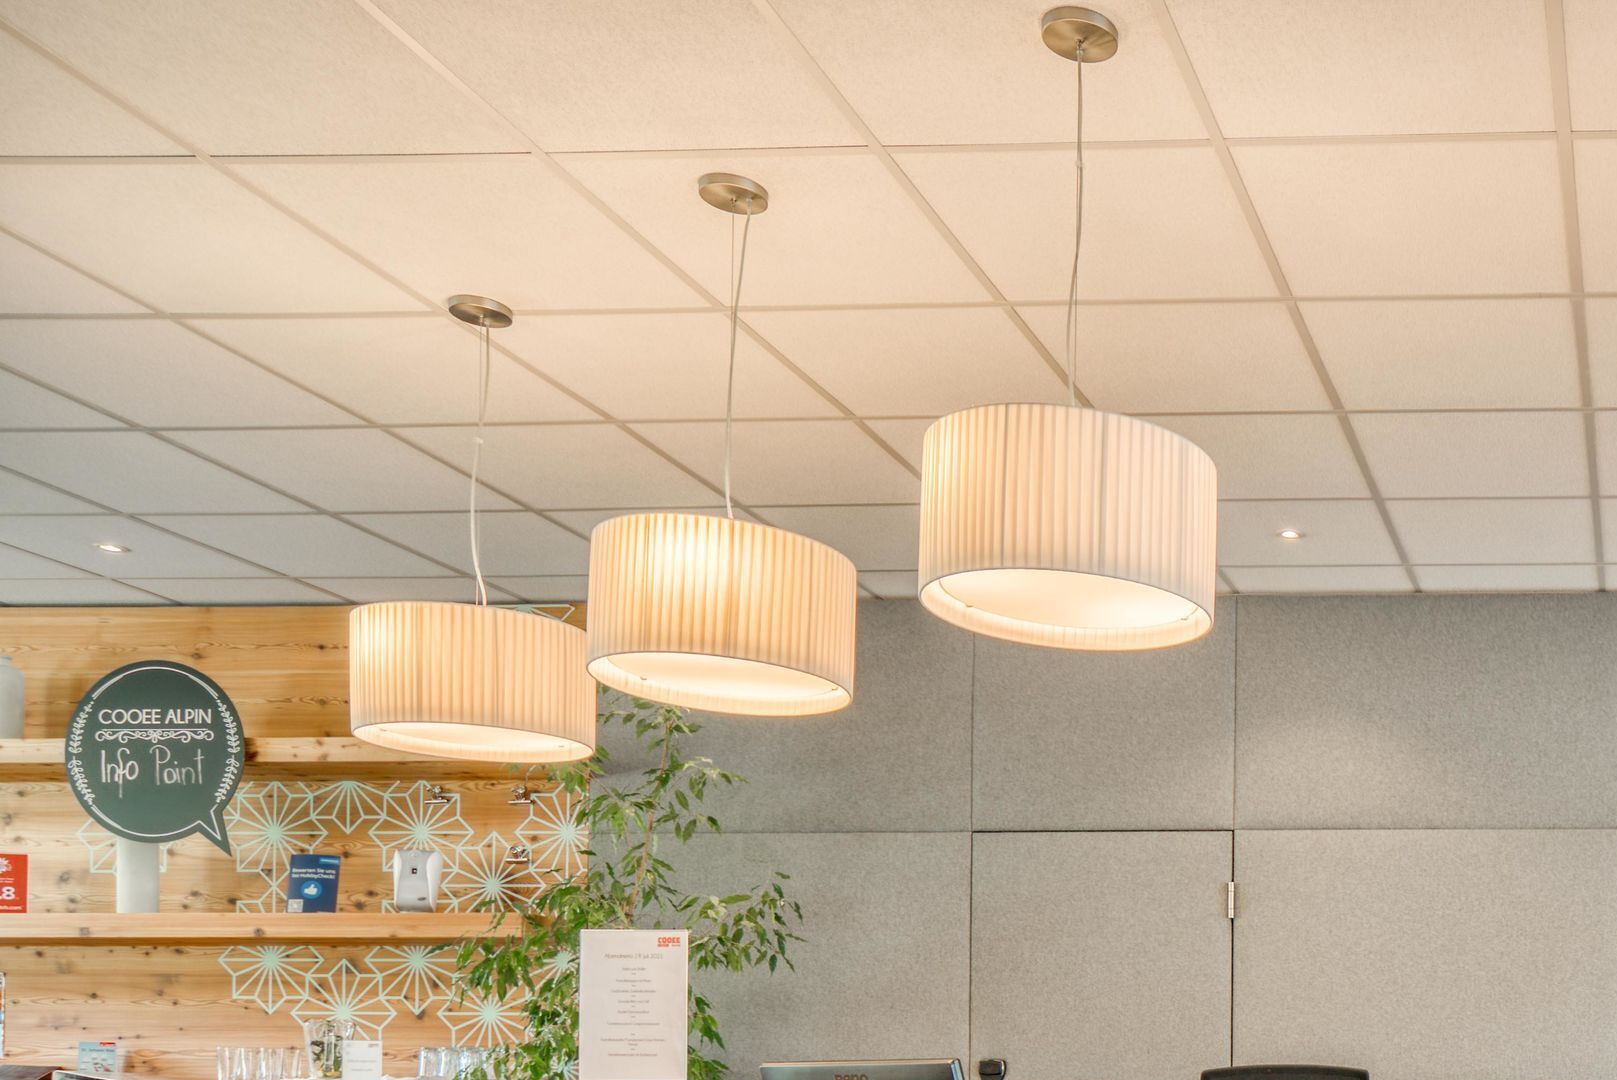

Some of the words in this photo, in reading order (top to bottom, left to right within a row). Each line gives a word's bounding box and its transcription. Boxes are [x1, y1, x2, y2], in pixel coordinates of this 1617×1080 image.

[98, 708, 161, 724] COOEE
[165, 708, 212, 724] ALPIN
[101, 747, 139, 798] Info
[150, 744, 205, 785] Point
